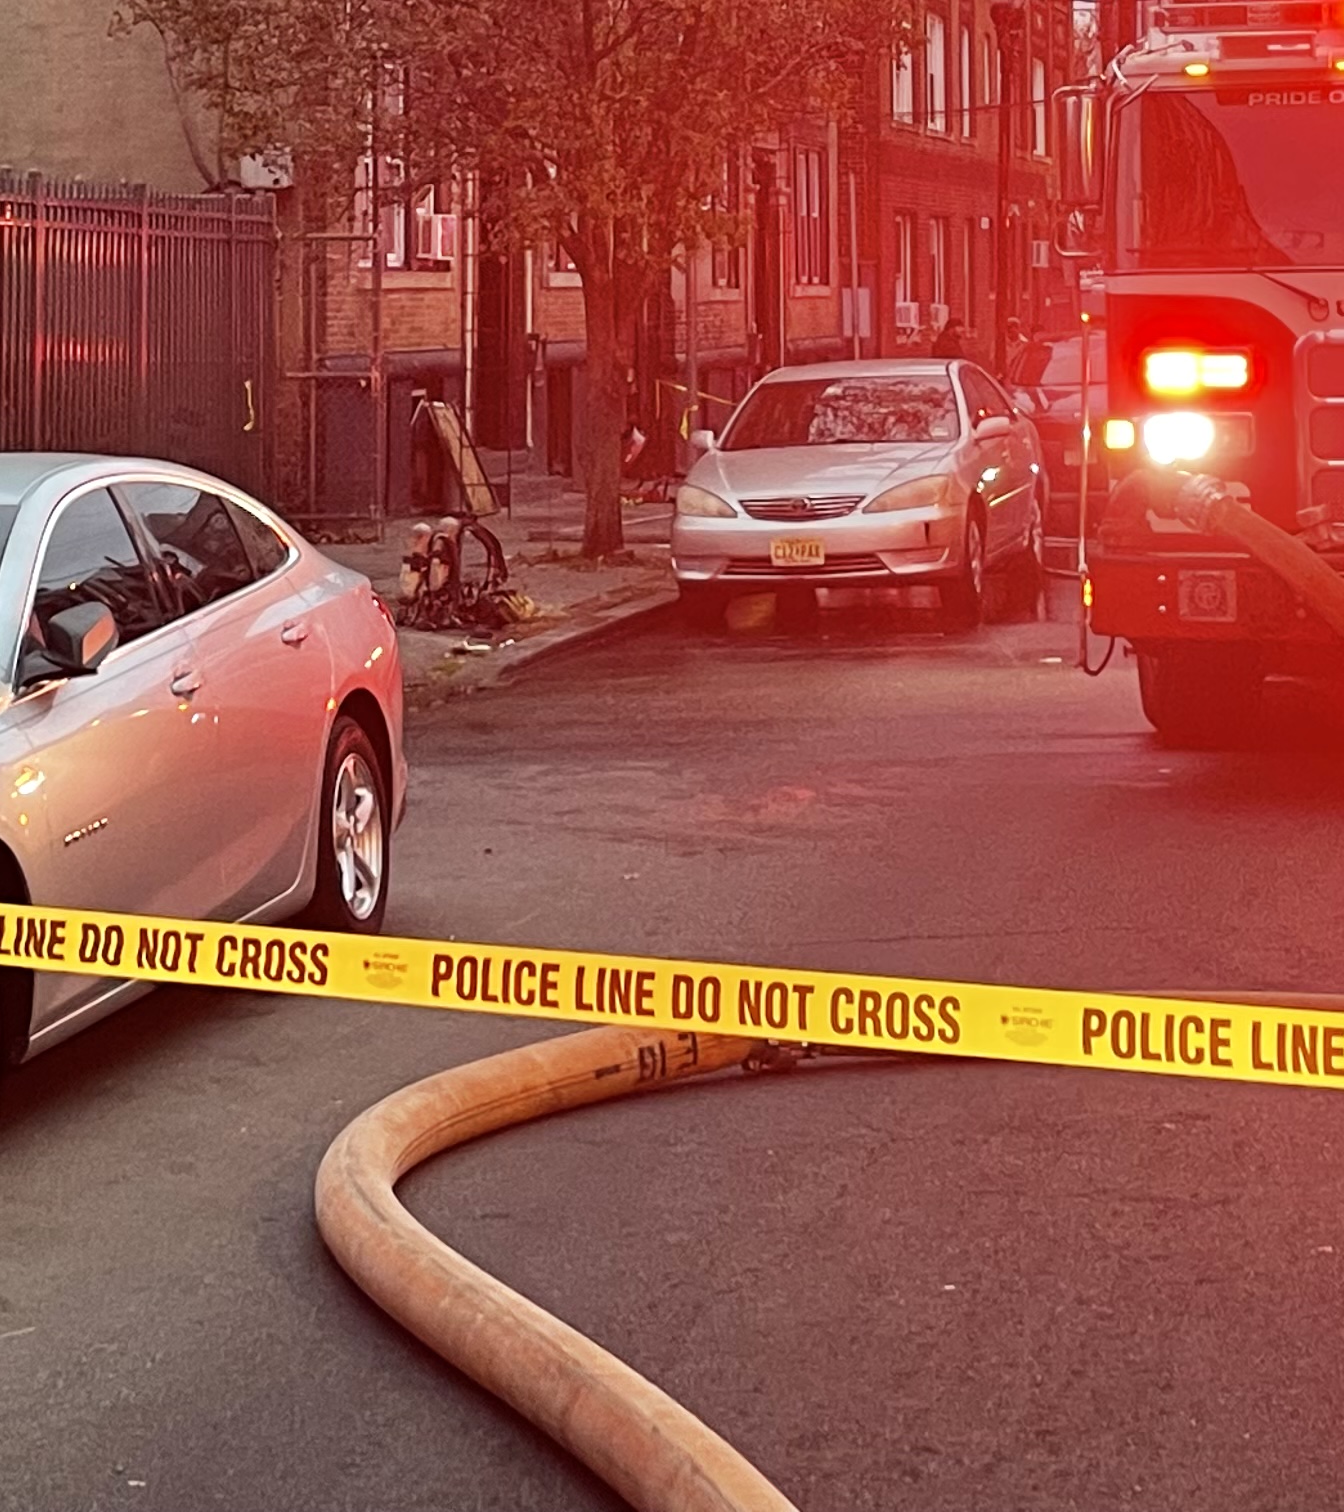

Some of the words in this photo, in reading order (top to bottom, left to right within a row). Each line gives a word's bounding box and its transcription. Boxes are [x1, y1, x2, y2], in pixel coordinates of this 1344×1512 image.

[1248, 91, 1321, 107] PRIDE
[79, 924, 123, 966] DO
[137, 928, 204, 973] NOT
[216, 936, 328, 985] CROSS
[432, 954, 560, 1008] POLICE
[576, 966, 655, 1016] LINE
[672, 975, 720, 1022] DO
[739, 980, 814, 1029] NOT
[831, 988, 959, 1043] CROSS
[1083, 1009, 1232, 1066] POLICE
[1252, 1022, 1344, 1075] LINE
